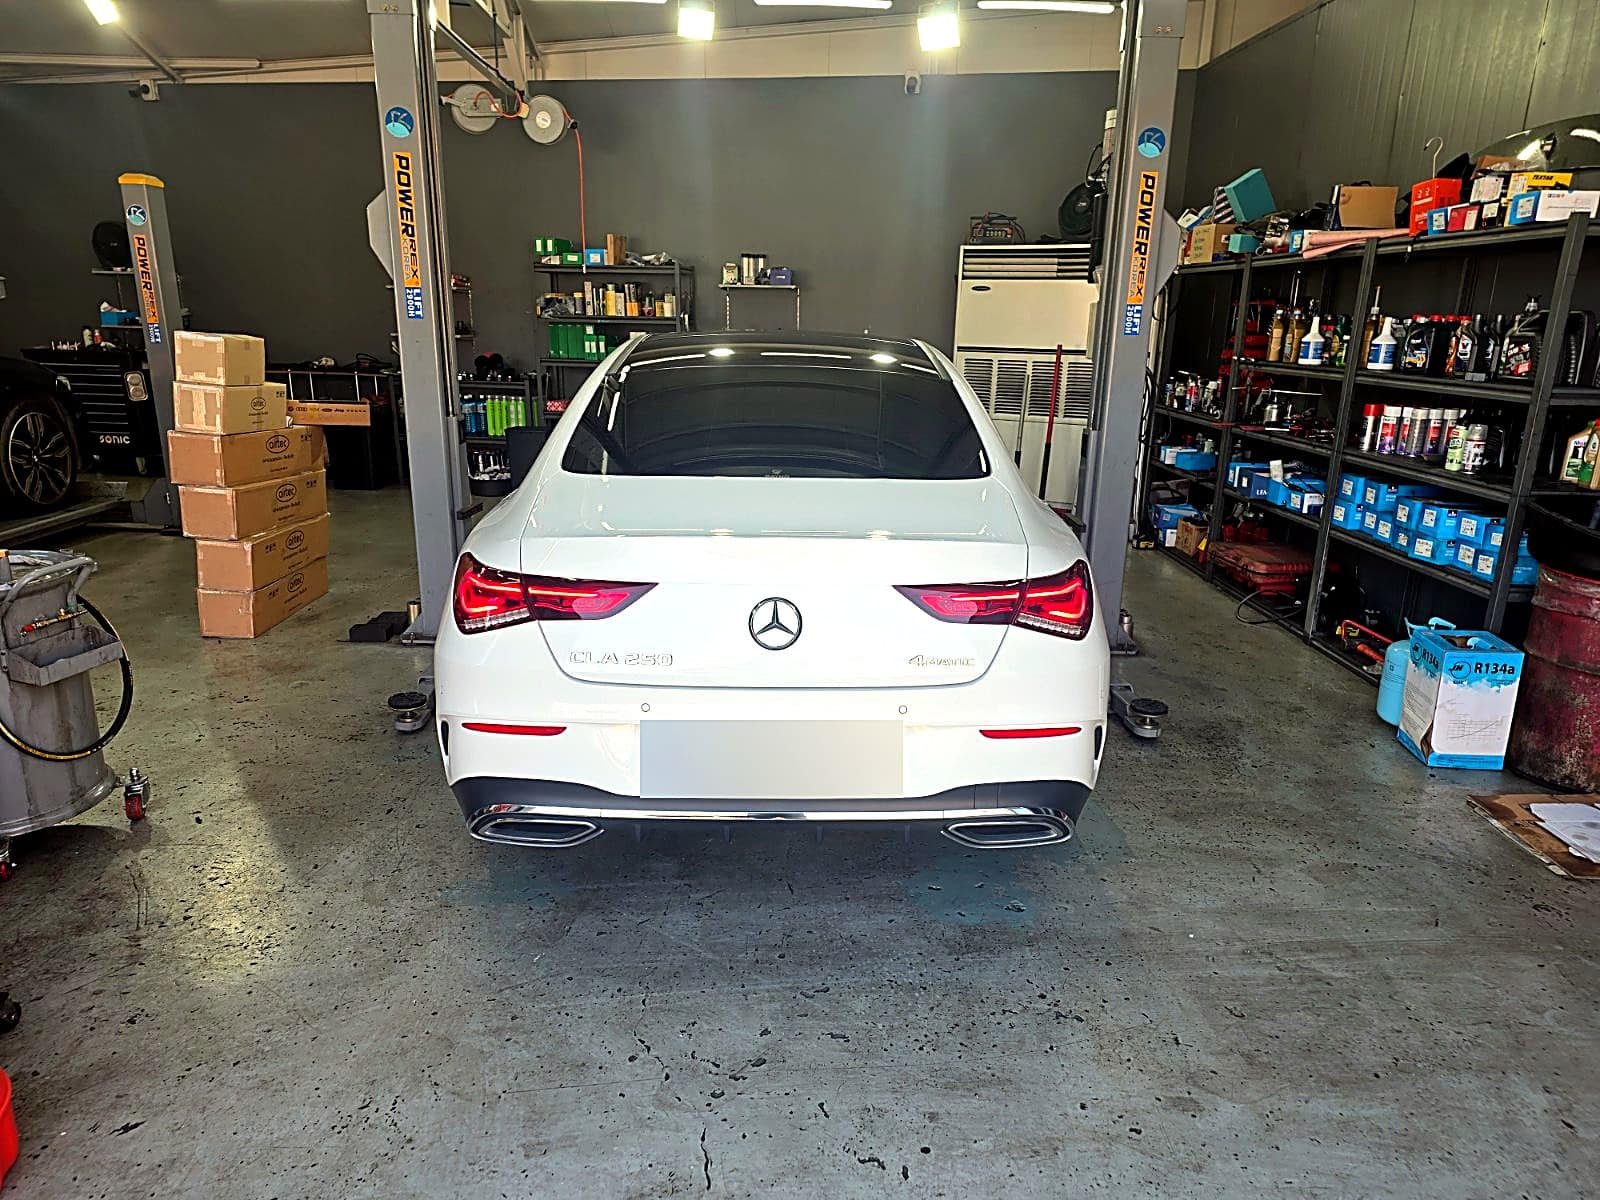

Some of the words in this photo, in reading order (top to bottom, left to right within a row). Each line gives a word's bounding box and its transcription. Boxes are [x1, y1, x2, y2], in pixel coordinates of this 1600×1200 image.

[402, 238, 412, 281] KOREA
[406, 288, 414, 317] 2900H
[414, 288, 423, 318] LIFT
[1124, 305, 1133, 334] 2900H
[1133, 305, 1142, 334] LIFT
[569, 651, 619, 664] CLA
[624, 653, 674, 666] 250
[1474, 662, 1515, 675] R134a
